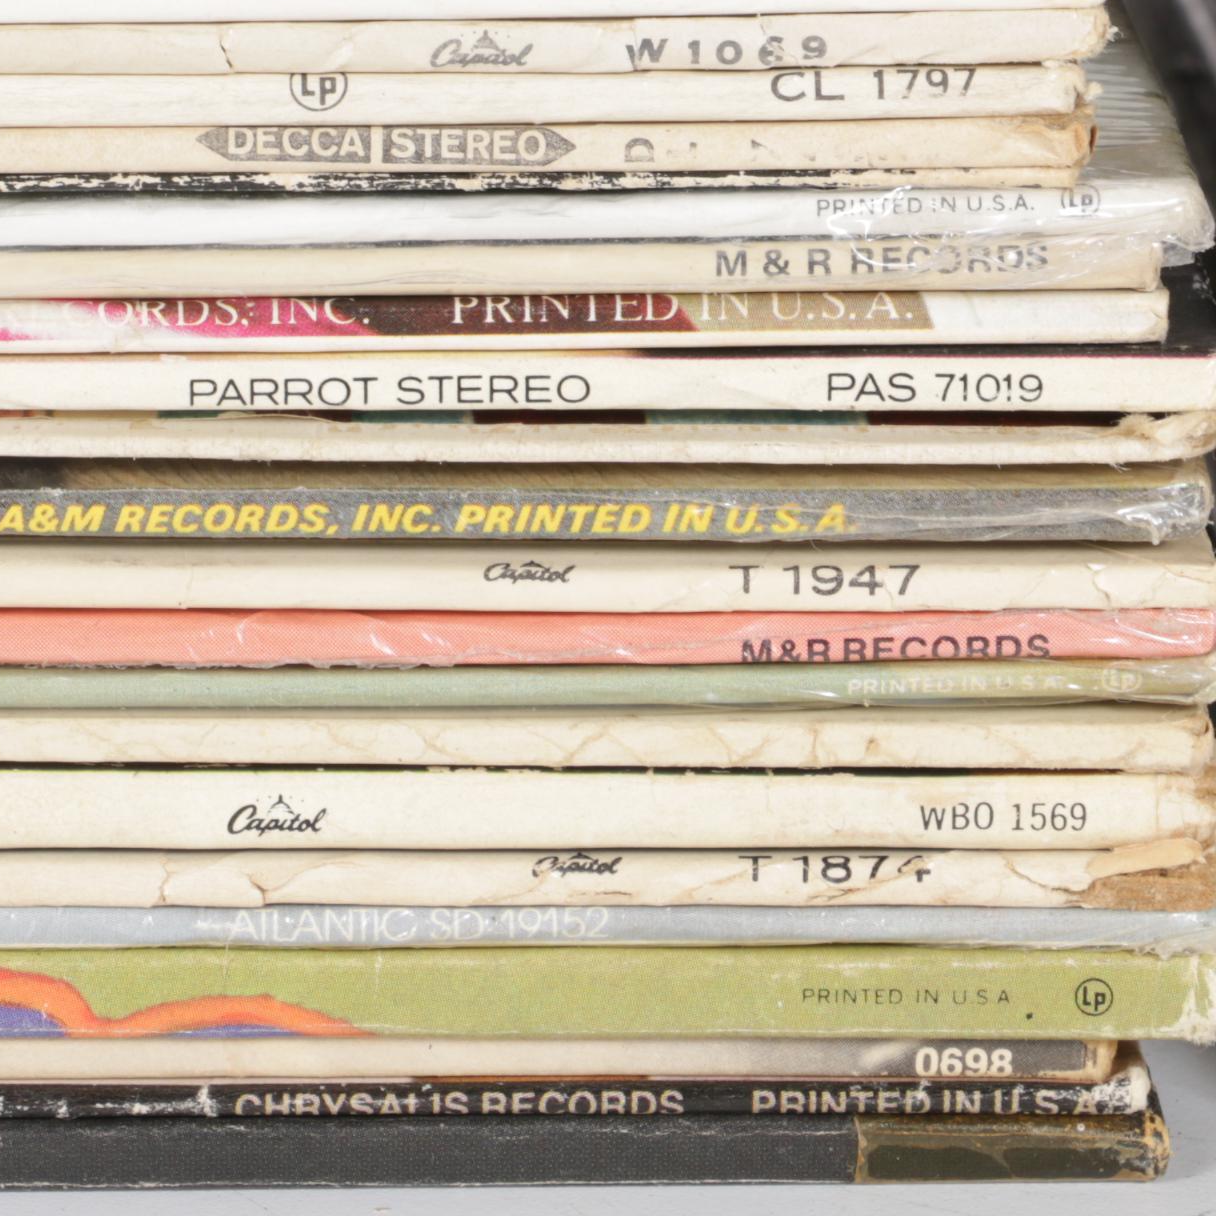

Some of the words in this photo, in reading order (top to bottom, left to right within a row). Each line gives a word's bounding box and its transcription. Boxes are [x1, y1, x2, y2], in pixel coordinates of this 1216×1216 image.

[429, 38, 534, 70] Capitol
[625, 37, 668, 69] W
[770, 71, 845, 103] CL
[872, 67, 978, 100] 1797
[226, 128, 366, 159] DECCA
[390, 130, 547, 162] STEREO
[816, 197, 925, 217] PRINTED
[967, 191, 1037, 213] U.S.A.
[716, 250, 748, 278] M
[762, 249, 790, 276] &
[807, 248, 833, 276] R
[851, 243, 1051, 276] RECORDS
[452, 294, 679, 325] PRINTED
[700, 293, 750, 321] IN
[771, 292, 914, 321] U.S.A.
[190, 378, 379, 408] PARROT
[395, 376, 591, 405] STEREO
[826, 374, 918, 403] PAS
[934, 373, 1045, 403] 71019
[115, 504, 340, 537] RECORDS,
[352, 504, 442, 531] INC.
[455, 503, 651, 532] PRINTED
[661, 504, 711, 531] IN
[722, 502, 858, 531] U.S.A.
[484, 561, 574, 584] Capitol
[729, 565, 760, 594] T
[783, 564, 921, 596] 1947
[843, 633, 1051, 661] RECORDS
[847, 677, 954, 695] PRINTED
[227, 803, 327, 836] Capitol
[919, 802, 994, 831] WBO
[1011, 802, 1087, 831] 1569
[738, 855, 772, 883] T
[429, 908, 483, 940] SD
[500, 907, 609, 939] 19152
[802, 988, 902, 1005] PRINTED
[916, 988, 938, 1004] IN
[915, 1047, 1014, 1076] 0698
[481, 1090, 684, 1114] RECORDS
[752, 1091, 930, 1115] PRINTED
[943, 1090, 981, 1114] IN
